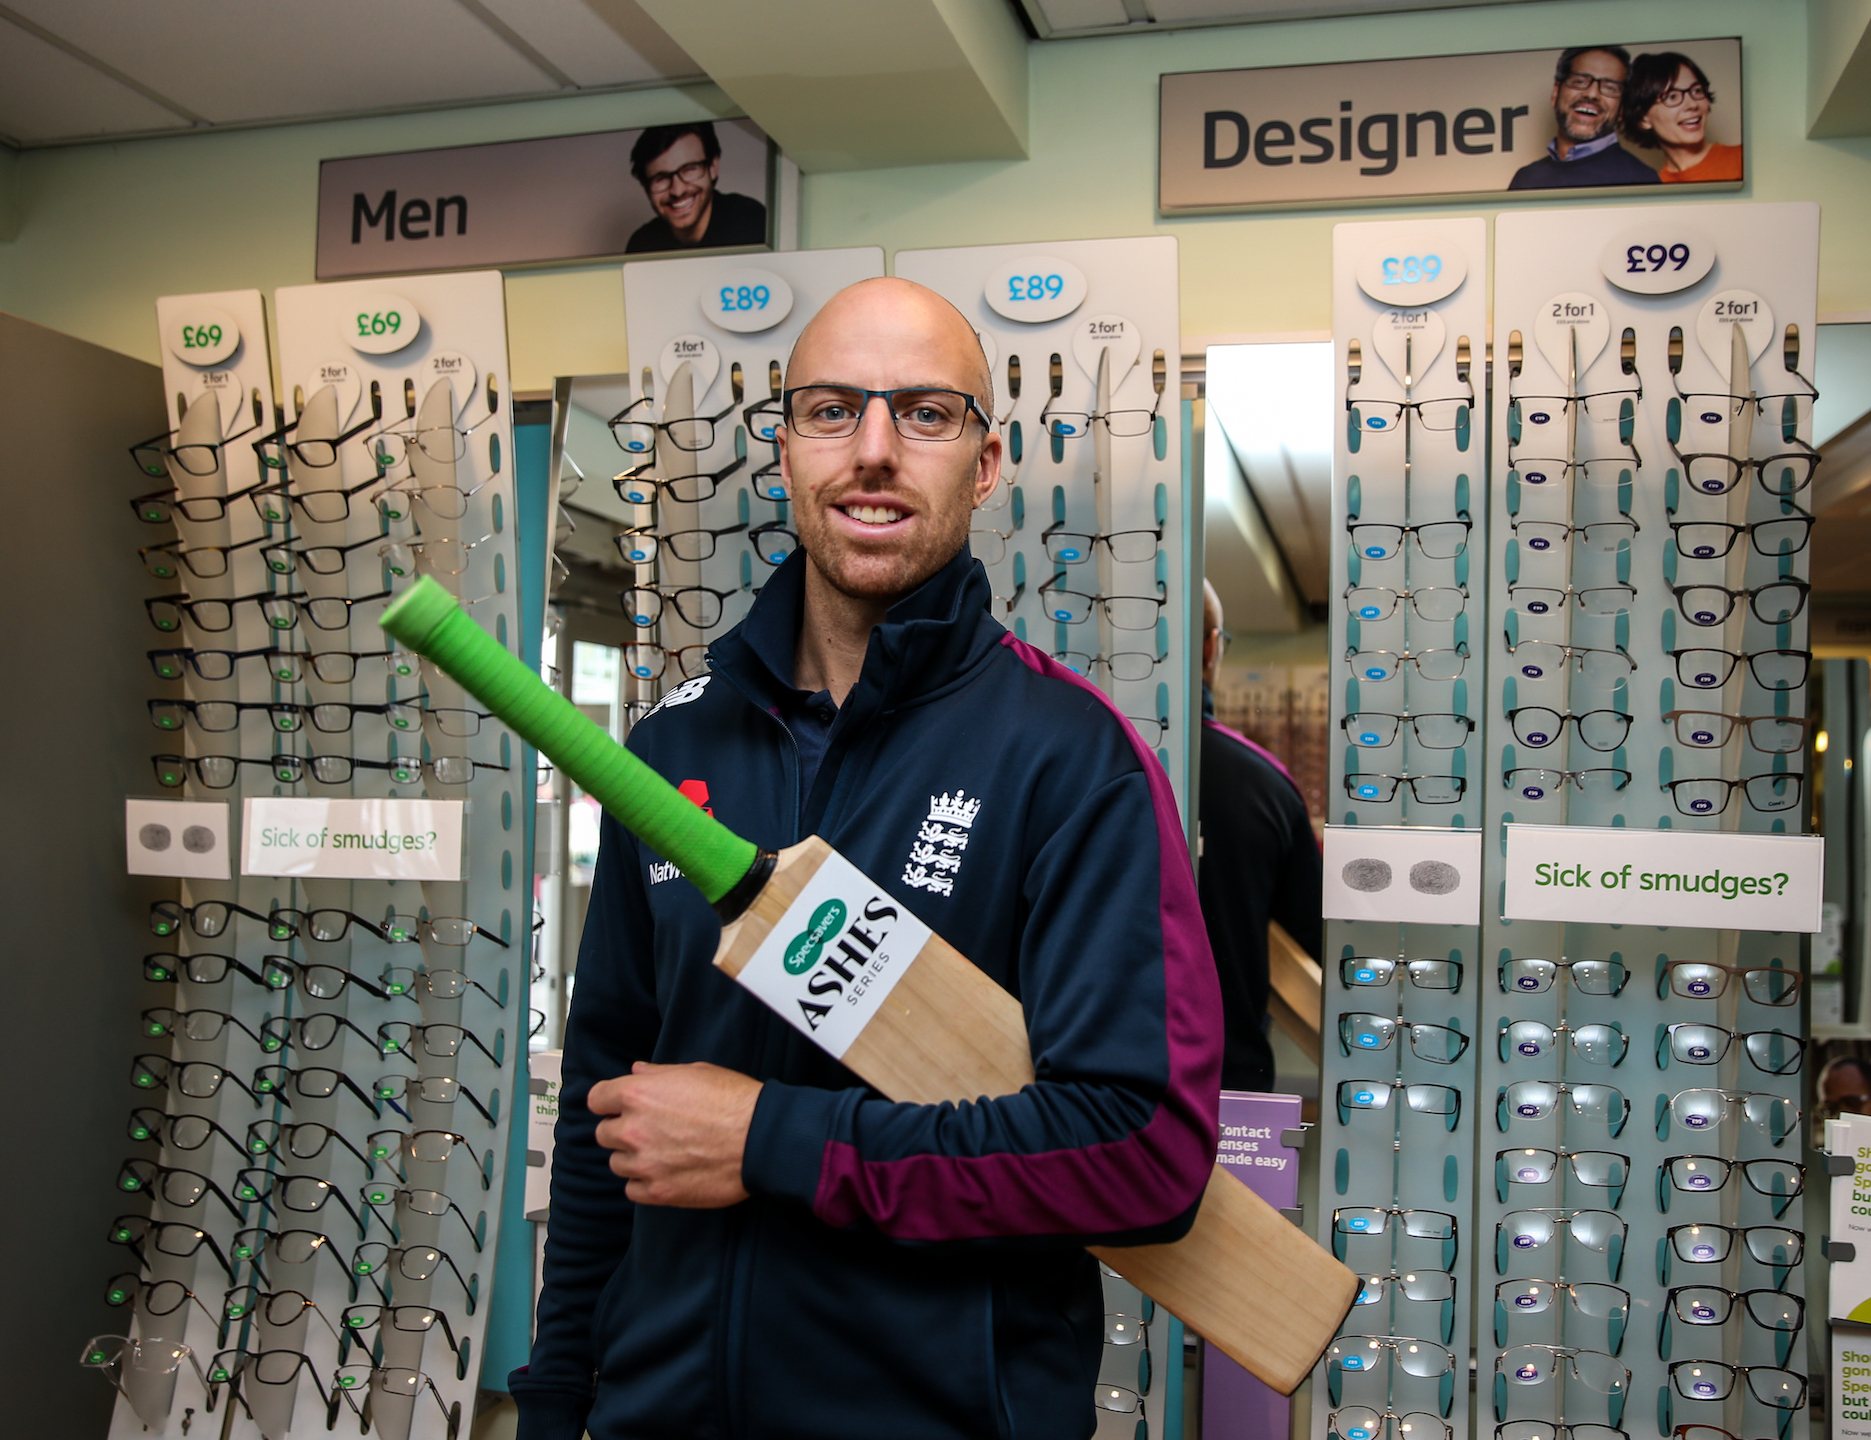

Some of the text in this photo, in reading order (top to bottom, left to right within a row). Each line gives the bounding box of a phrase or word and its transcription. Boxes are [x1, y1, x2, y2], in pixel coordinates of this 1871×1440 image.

[1203, 100, 1530, 177] Designer
[350, 189, 468, 245] Men
[1381, 254, 1443, 285] £89
[1626, 243, 1691, 273] £99
[719, 284, 770, 312] £89
[1008, 274, 1064, 302] £89
[1391, 310, 1428, 324] 2 for 1
[1552, 302, 1594, 317] 2 for 1
[1714, 300, 1758, 315] 2 for 1
[356, 311, 401, 336] £69
[1089, 321, 1124, 334] 2 for 1
[183, 324, 222, 348] £69
[674, 340, 704, 353] 2 for 1
[321, 367, 326, 378] 2
[327, 366, 342, 378] for
[433, 358, 440, 369] 2
[441, 356, 456, 368] for
[202, 373, 209, 384] 2
[210, 372, 223, 384] for
[261, 826, 437, 854] Sick of smudges?
[649, 860, 686, 886] NatW
[1534, 862, 1790, 900] Sick of smudges?
[788, 904, 841, 969] Specsavers
[796, 896, 899, 1032] ASHES
[847, 951, 890, 1006] SERIES
[1216, 1153, 1288, 1171] made easy
[1848, 1223, 1865, 1232] Now
[1842, 1350, 1871, 1364] Sho
[1842, 1380, 1871, 1395] Spe
[1842, 1394, 1869, 1408] but
